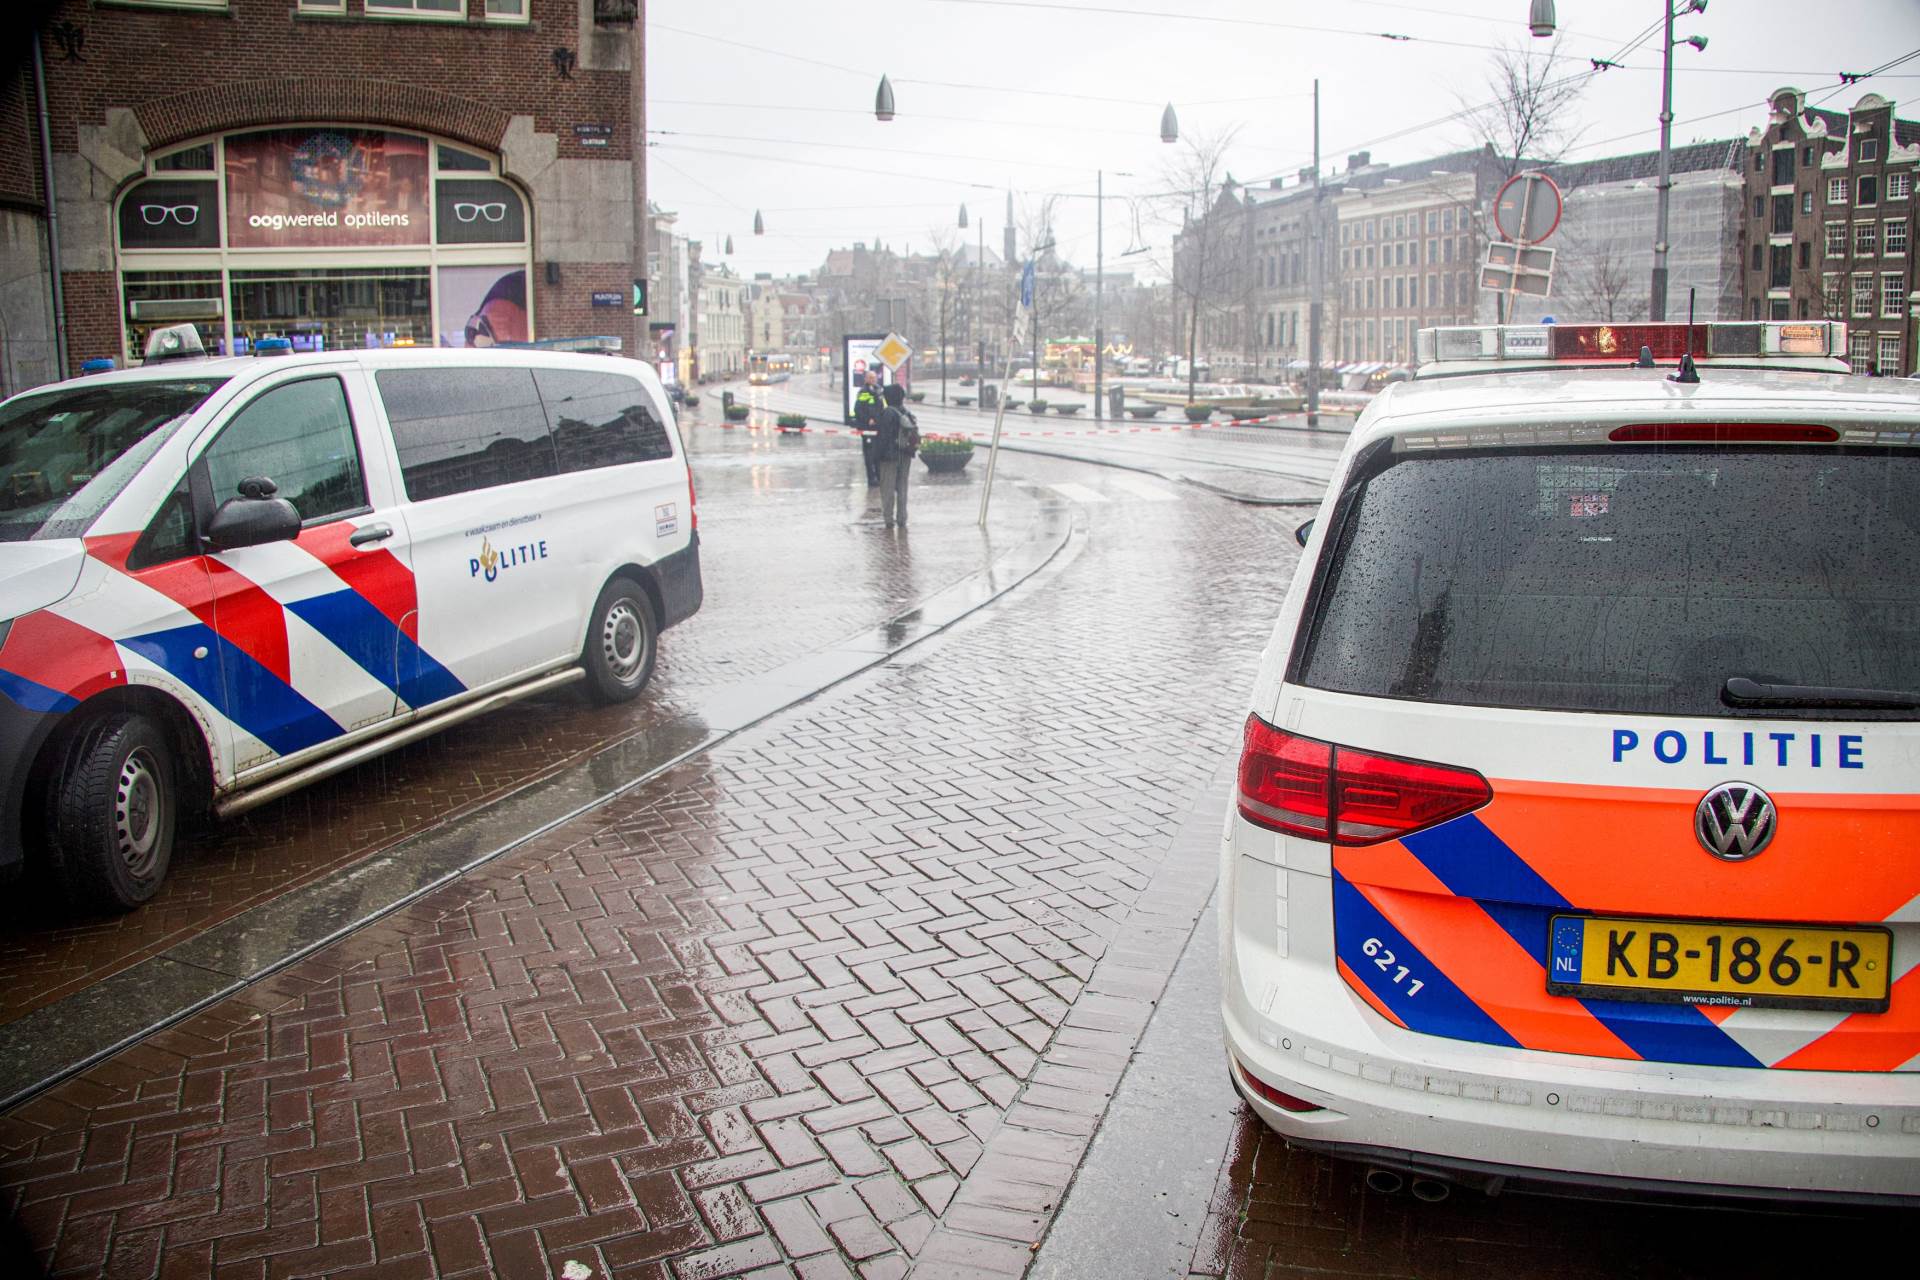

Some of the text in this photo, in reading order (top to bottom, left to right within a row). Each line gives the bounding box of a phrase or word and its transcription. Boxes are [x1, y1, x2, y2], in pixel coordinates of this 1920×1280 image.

[249, 211, 409, 230] oogwereld optilens
[470, 540, 548, 582] POLITIE
[1613, 729, 1864, 769] POLITIE
[1362, 937, 1425, 997] 6211
[1556, 929, 1861, 989] NL KB-186-R
[1682, 995, 1752, 1006] www.politie.nl
